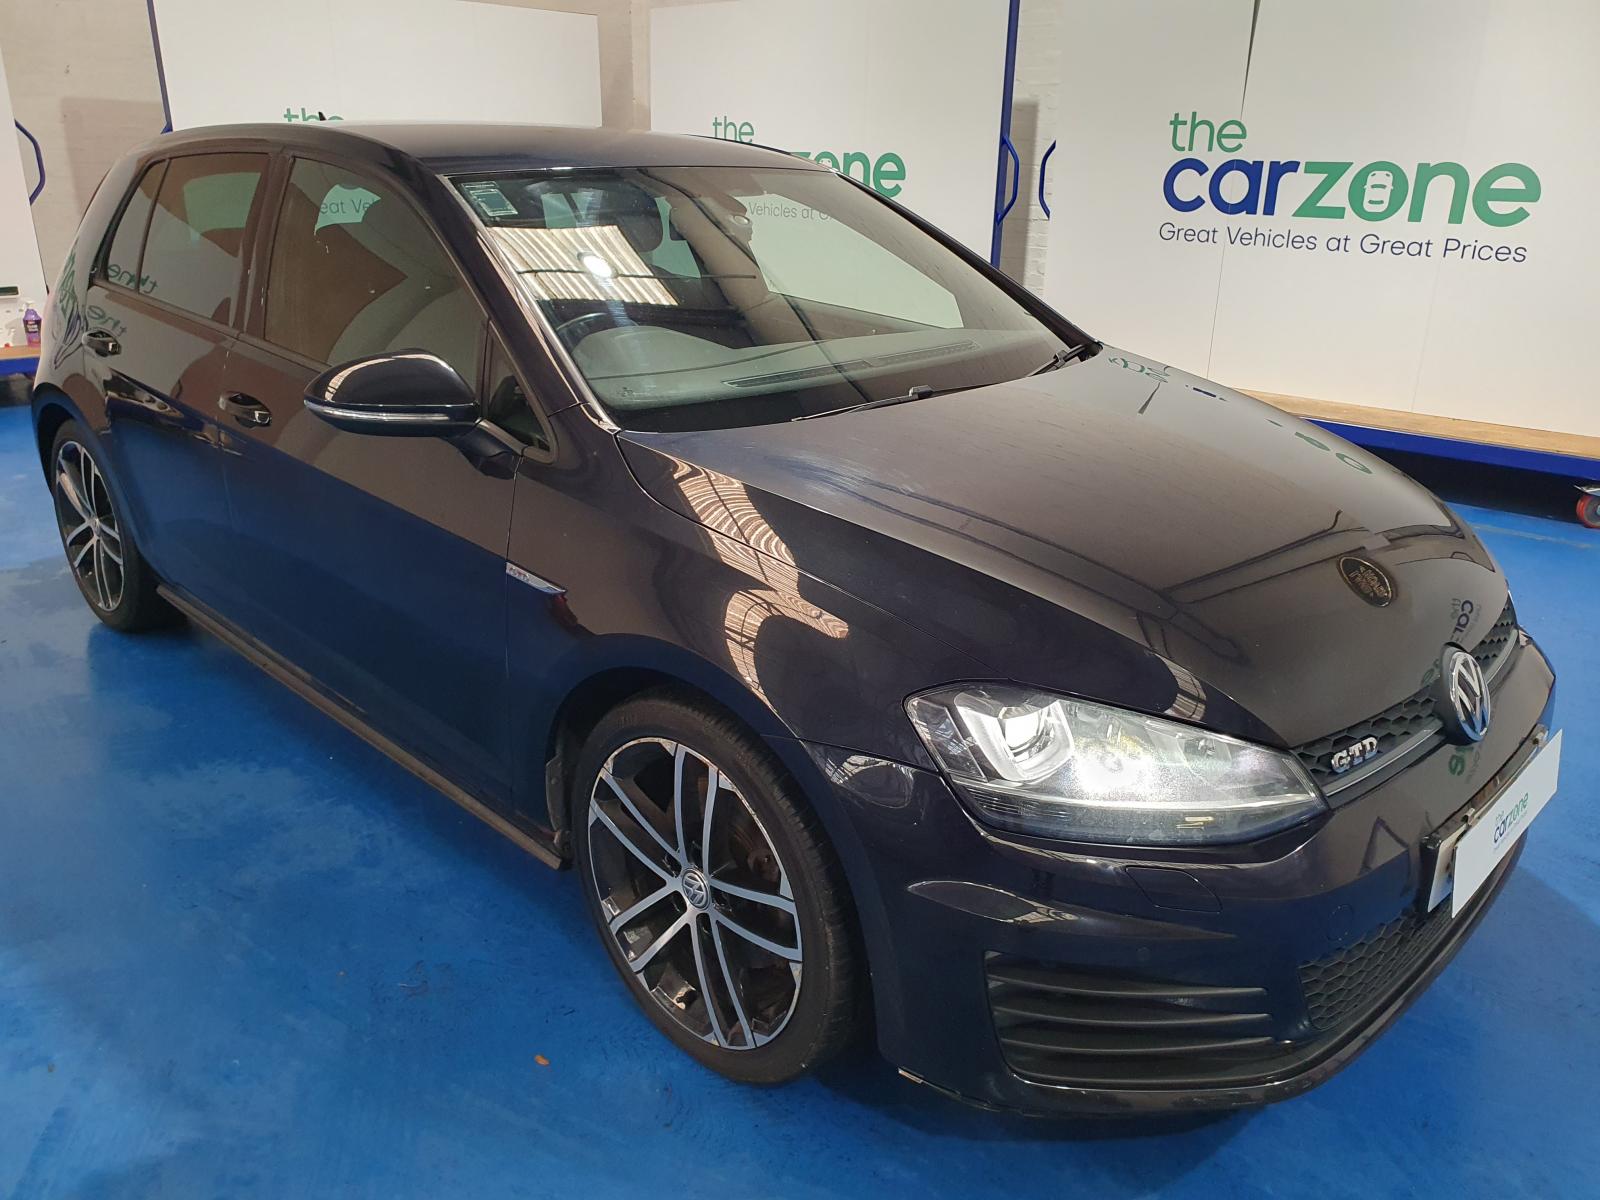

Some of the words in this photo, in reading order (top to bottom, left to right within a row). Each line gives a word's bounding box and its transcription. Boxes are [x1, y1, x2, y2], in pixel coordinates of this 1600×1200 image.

[283, 107, 344, 122] th
[712, 115, 755, 144] the
[1169, 111, 1248, 153] the
[748, 202, 797, 218] Vehicles
[1163, 158, 1541, 227] carzone
[1159, 222, 1219, 244] Great
[1227, 226, 1318, 251] Vehicles
[1326, 234, 1351, 253] at
[1360, 233, 1433, 257] Great
[1443, 238, 1528, 263] Prices
[1331, 736, 1378, 774] GTD
